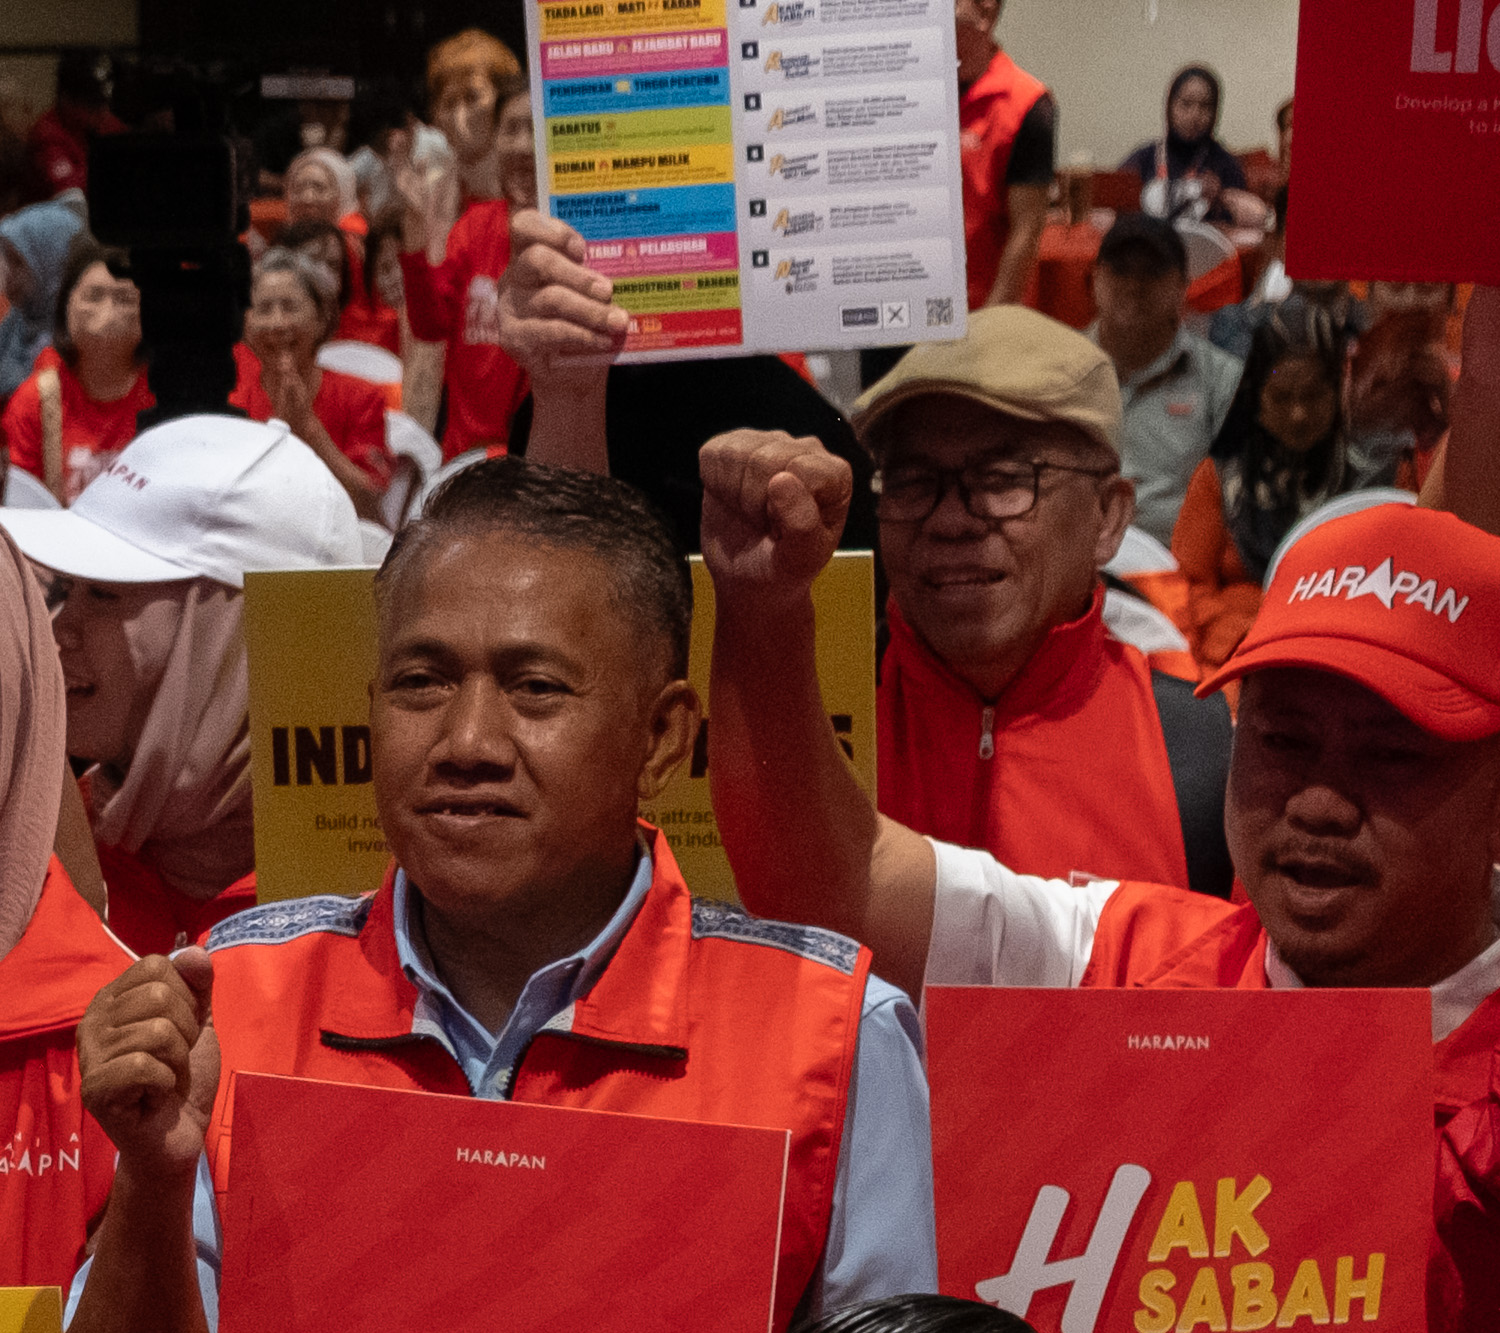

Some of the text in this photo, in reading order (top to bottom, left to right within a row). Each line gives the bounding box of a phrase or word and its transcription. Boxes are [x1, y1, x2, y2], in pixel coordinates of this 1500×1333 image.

[1288, 557, 1469, 623] HARAPAN
[1128, 1035, 1210, 1050] HARAPAN
[456, 1147, 546, 1170] HARAPAN
